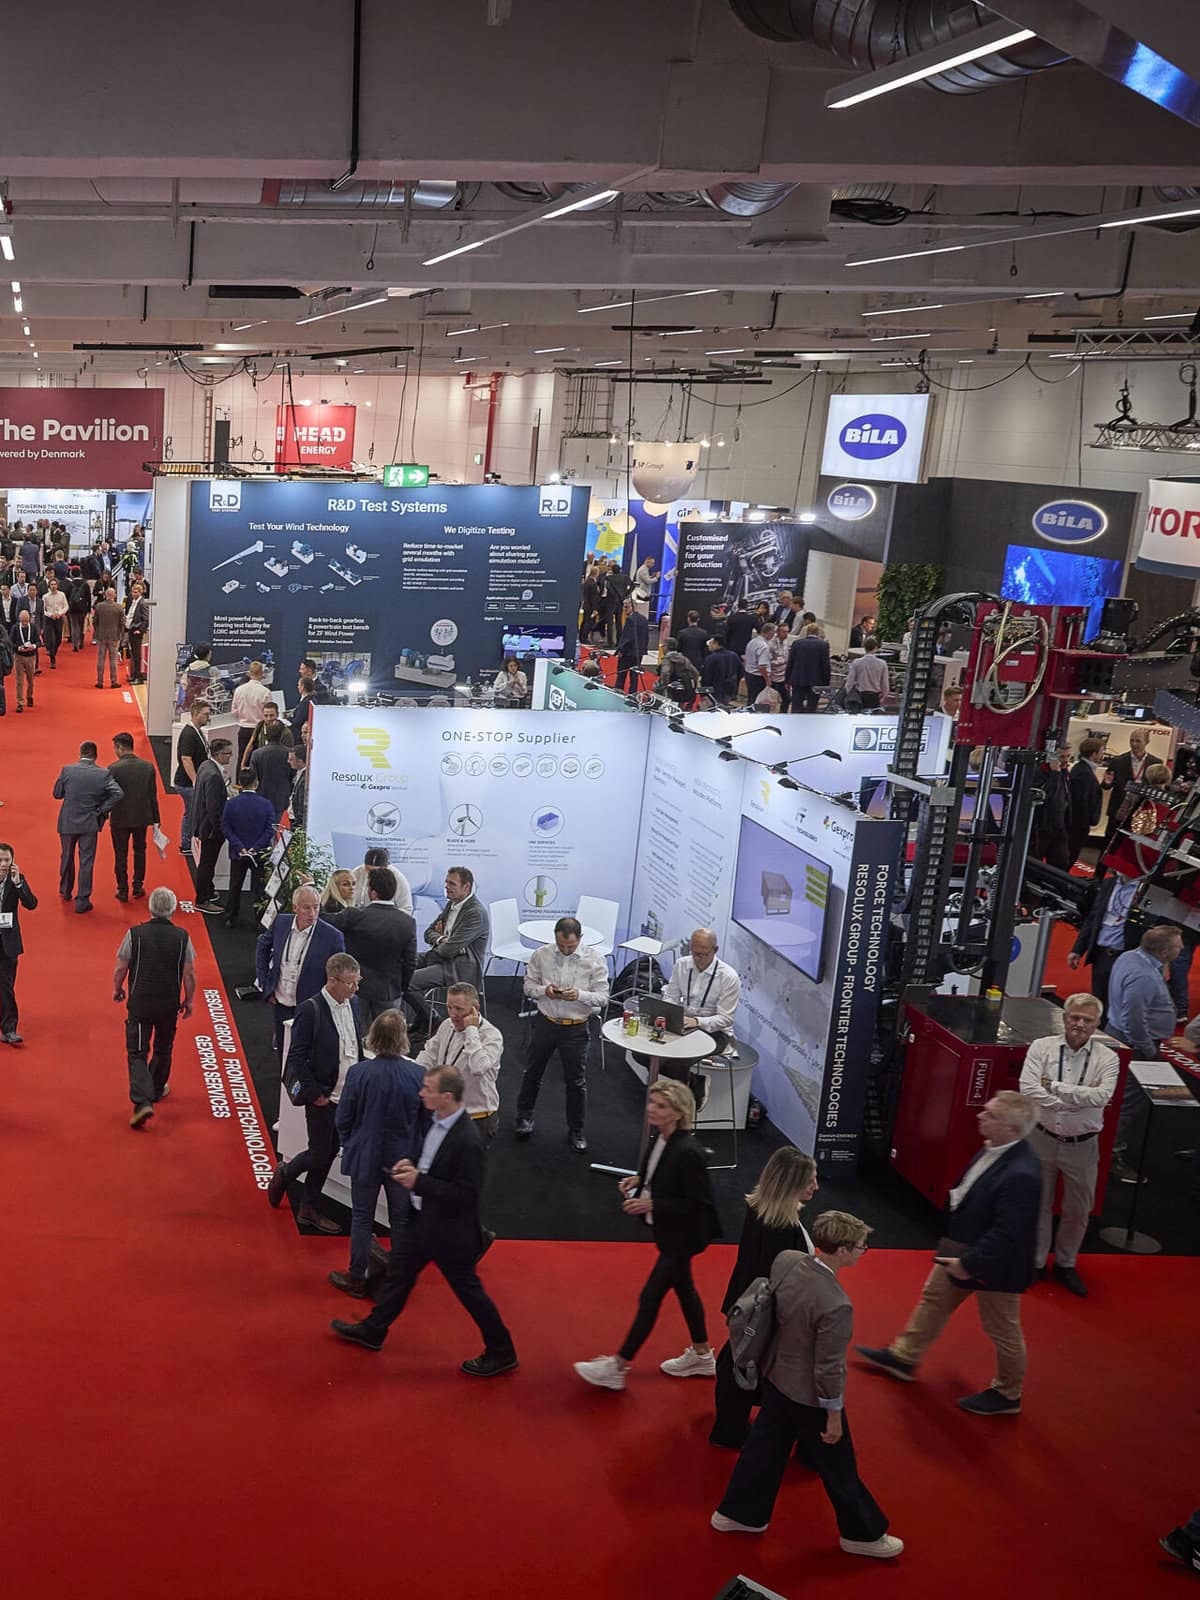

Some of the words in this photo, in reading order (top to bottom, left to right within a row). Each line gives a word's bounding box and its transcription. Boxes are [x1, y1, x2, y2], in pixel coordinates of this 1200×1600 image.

[43, 418, 149, 442] Pavilion
[294, 426, 346, 442] HEAD
[27, 449, 40, 461] by
[41, 449, 86, 459] Denmark
[301, 446, 337, 455] ENERGY
[328, 499, 356, 512] R&D
[360, 499, 387, 513] Test
[390, 500, 448, 516] Systems
[248, 523, 265, 531] Test
[266, 523, 284, 531] Your
[285, 523, 305, 531] Wind
[306, 523, 350, 534] Technology
[443, 526, 457, 534] We
[458, 526, 486, 536] Digitize
[488, 526, 516, 537] Testing
[686, 534, 729, 542] Customised
[505, 551, 526, 559] sharing
[685, 544, 725, 552] equipment
[683, 561, 723, 569] production
[697, 553, 715, 561] your
[214, 622, 233, 630] bearing
[245, 622, 262, 630] facility
[228, 615, 252, 623] powerful
[441, 730, 514, 743] ONE-STOP
[518, 732, 577, 746] Supplier
[331, 771, 373, 783] Resolux
[375, 772, 409, 785] Group
[368, 783, 391, 791] Gexpro
[831, 821, 854, 842] Gexpro
[850, 864, 870, 922] RESOLUX
[873, 864, 889, 906] FORCE
[846, 923, 862, 965] GROUP
[863, 906, 884, 993] TECHNOLOGY
[203, 989, 228, 1024] RESOLUX
[836, 975, 855, 1033] FRONTIER
[213, 1023, 236, 1054] GROUP
[194, 1035, 218, 1072] GEXPRO
[222, 1058, 251, 1104] FRONTIER
[826, 1034, 847, 1128] TECHNOLOGIES
[972, 1063, 988, 1100] FUWI-4
[203, 1070, 231, 1119] SERVICES
[236, 1103, 275, 1190] TECHNOLOGIES
